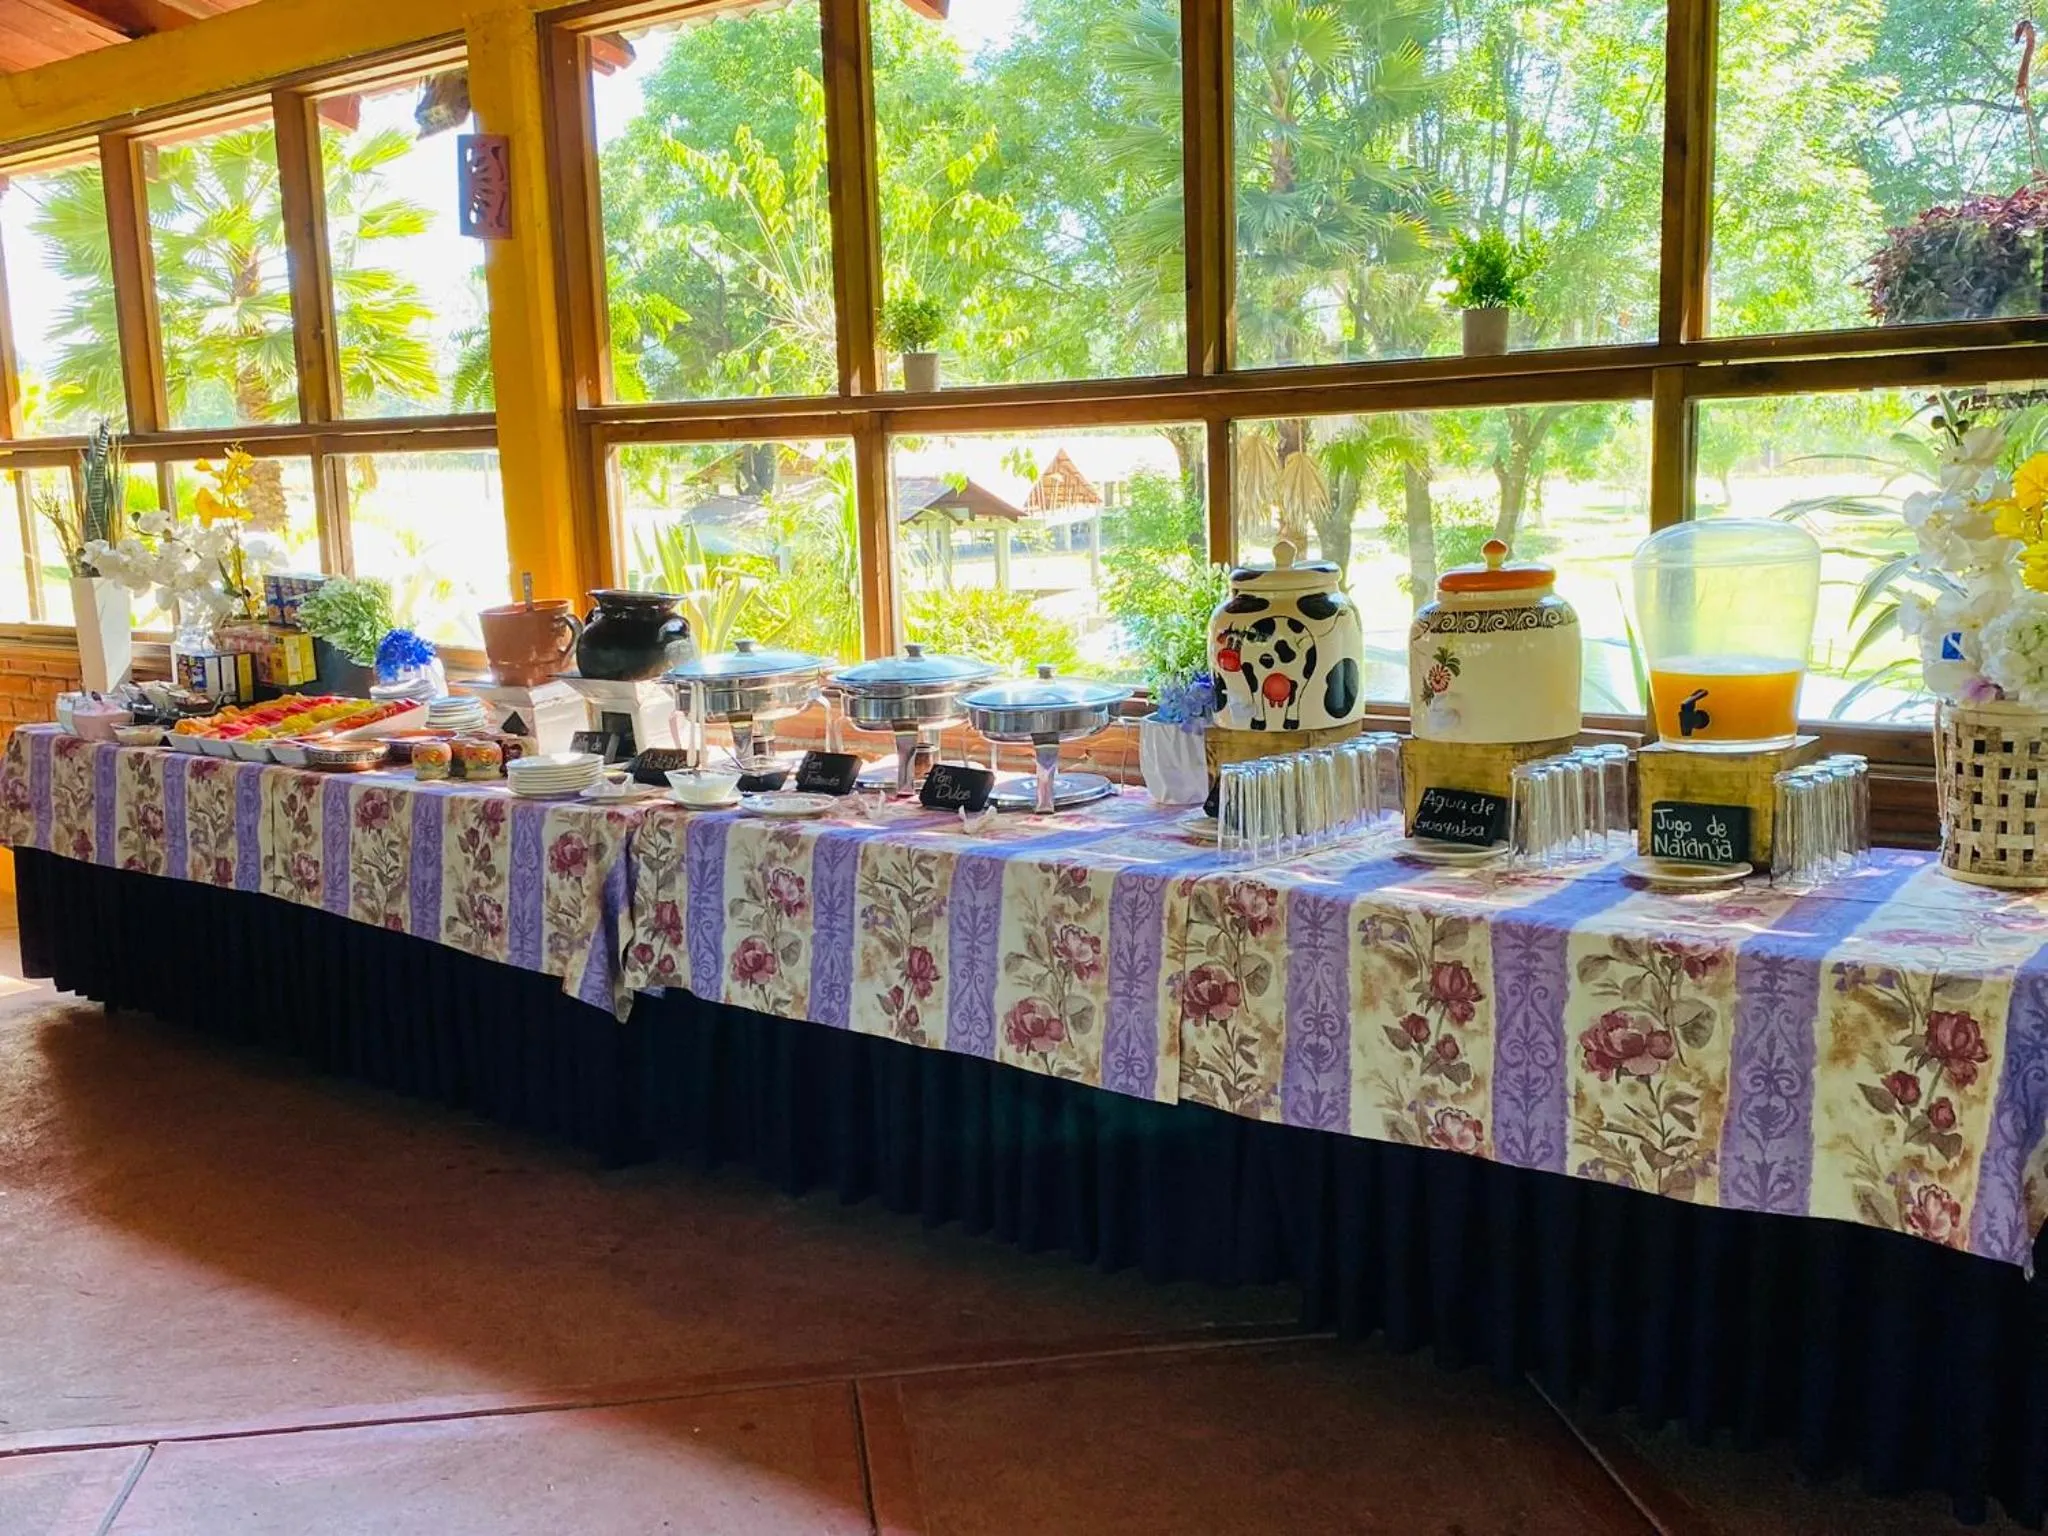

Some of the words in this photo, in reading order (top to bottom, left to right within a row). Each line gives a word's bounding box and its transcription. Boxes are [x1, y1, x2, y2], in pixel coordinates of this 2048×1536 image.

[932, 765, 953, 784] Pan
[935, 782, 971, 801] Dulce
[1422, 789, 1468, 814] Agua
[1470, 797, 1496, 816] de
[1652, 807, 1693, 839] Jugo
[1706, 813, 1728, 838] de
[1653, 832, 1734, 861] Naranja
